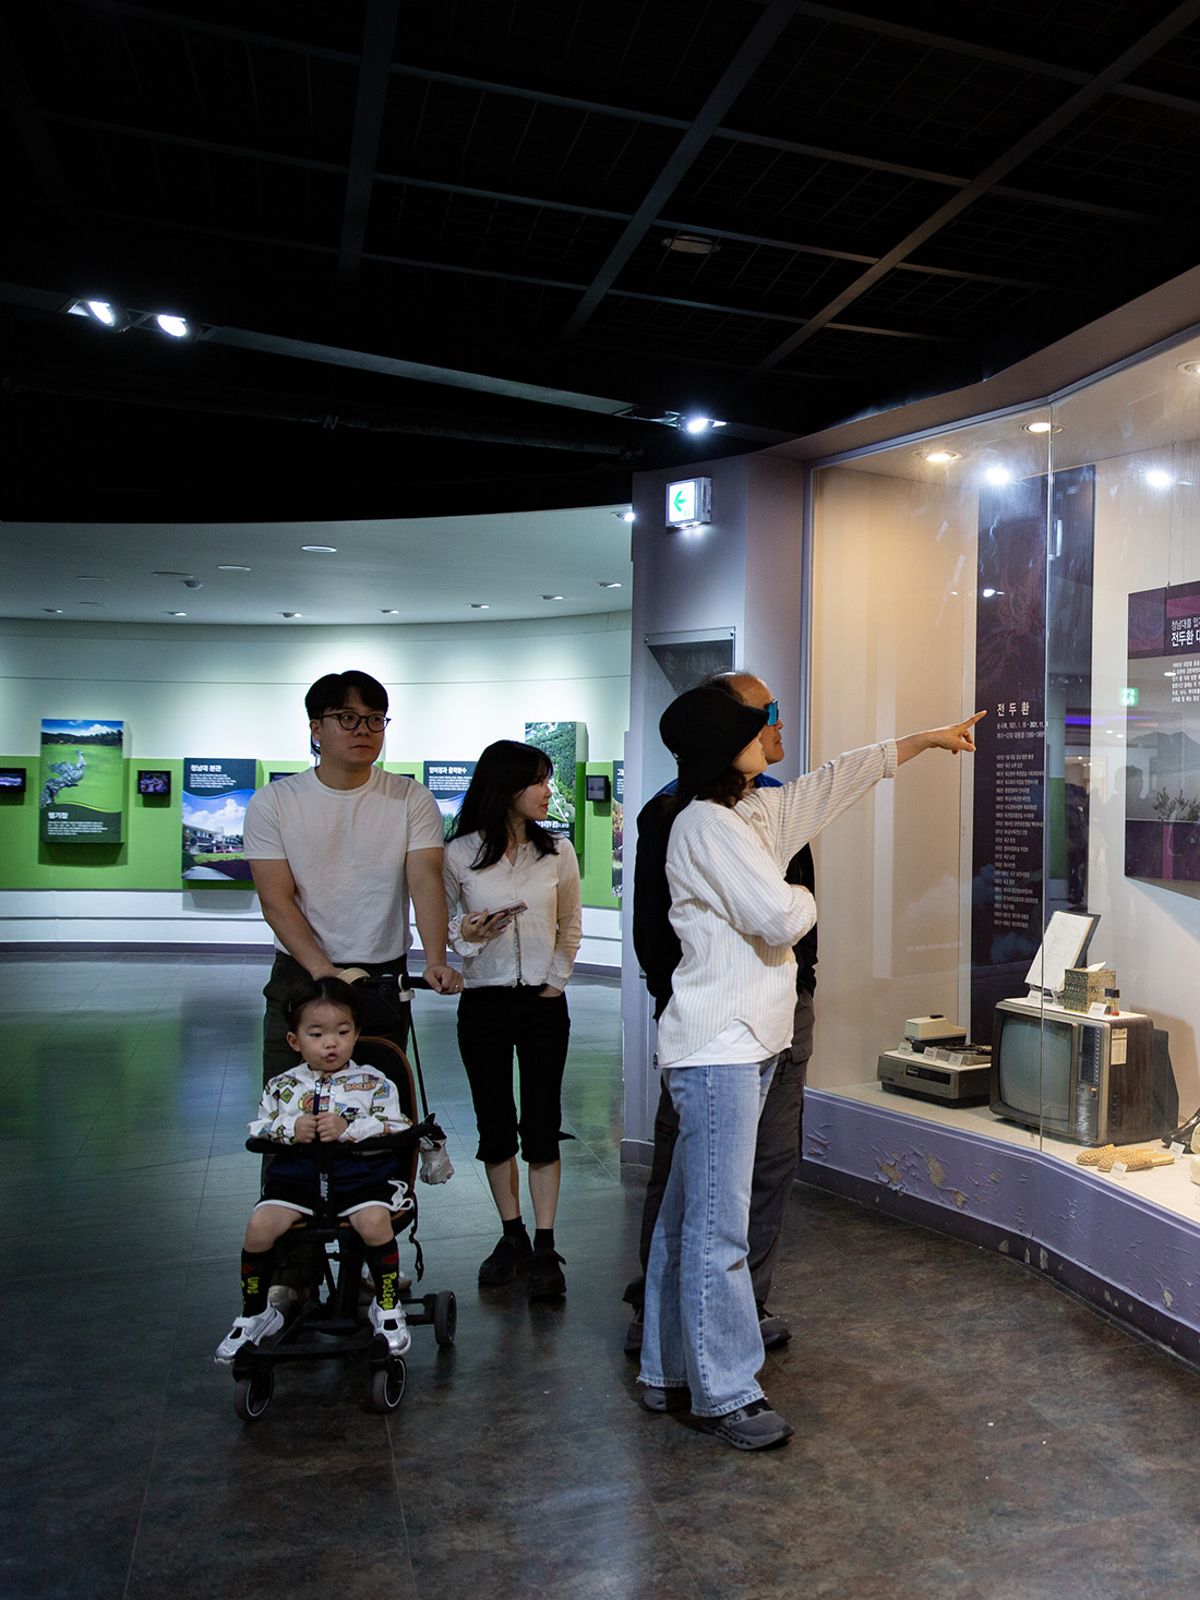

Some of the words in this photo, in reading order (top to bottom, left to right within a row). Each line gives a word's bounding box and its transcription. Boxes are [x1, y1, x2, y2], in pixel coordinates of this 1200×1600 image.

[1171, 618, 1192, 631] 청남대를
[1171, 629, 1194, 647] 전두환
[997, 701, 1030, 717] 전두환
